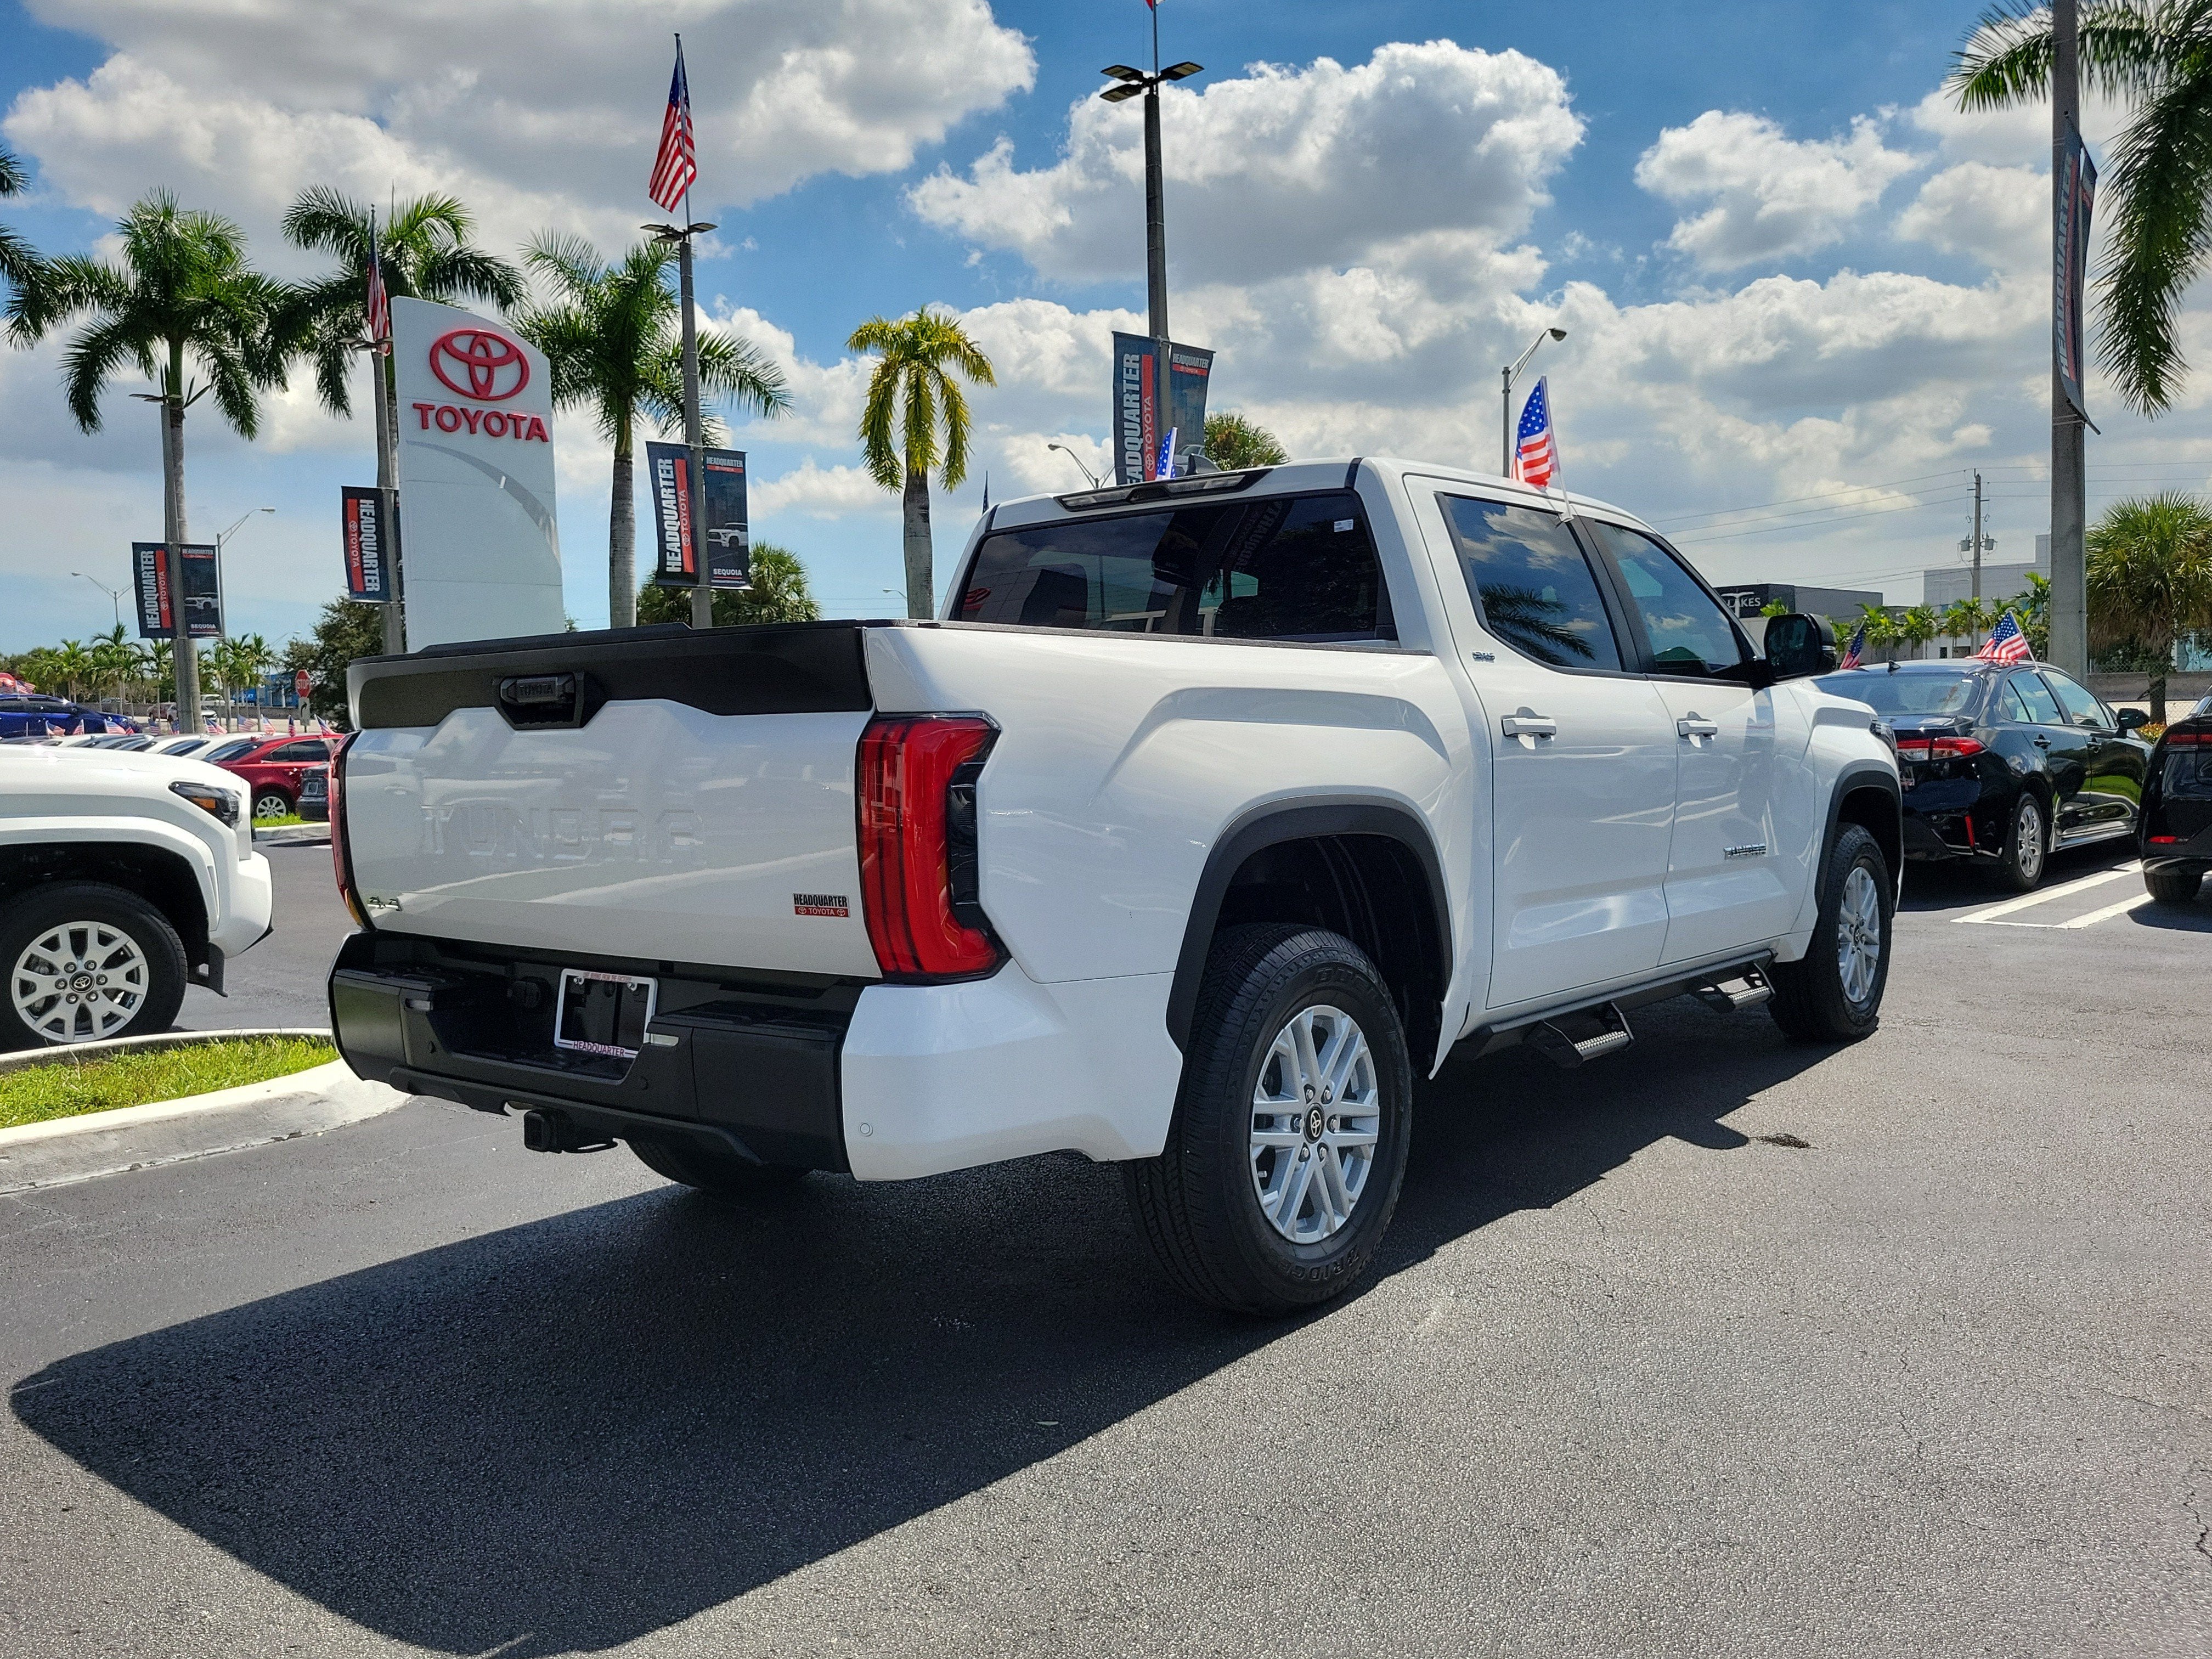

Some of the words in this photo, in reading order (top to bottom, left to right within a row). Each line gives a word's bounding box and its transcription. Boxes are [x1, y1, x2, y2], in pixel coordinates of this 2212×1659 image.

[2056, 153, 2072, 377] HEADQUARTER
[413, 403, 549, 442] TOYOTA
[1123, 353, 1143, 485] EADQUARTER
[1144, 396, 1153, 453] TOYOTA
[657, 458, 682, 572] HEADQUARTER
[679, 490, 689, 533] TOYOTA
[350, 532, 360, 568] TOYOTA
[359, 499, 380, 592] HEADQUARTER
[140, 550, 161, 629] HEADQUARTER
[159, 571, 167, 602] TOYOTA
[296, 679, 310, 689] STOP
[420, 805, 706, 864] TUNDRA
[794, 894, 848, 907] HEADQUARTER
[573, 1041, 625, 1057] HEADQUARTER
